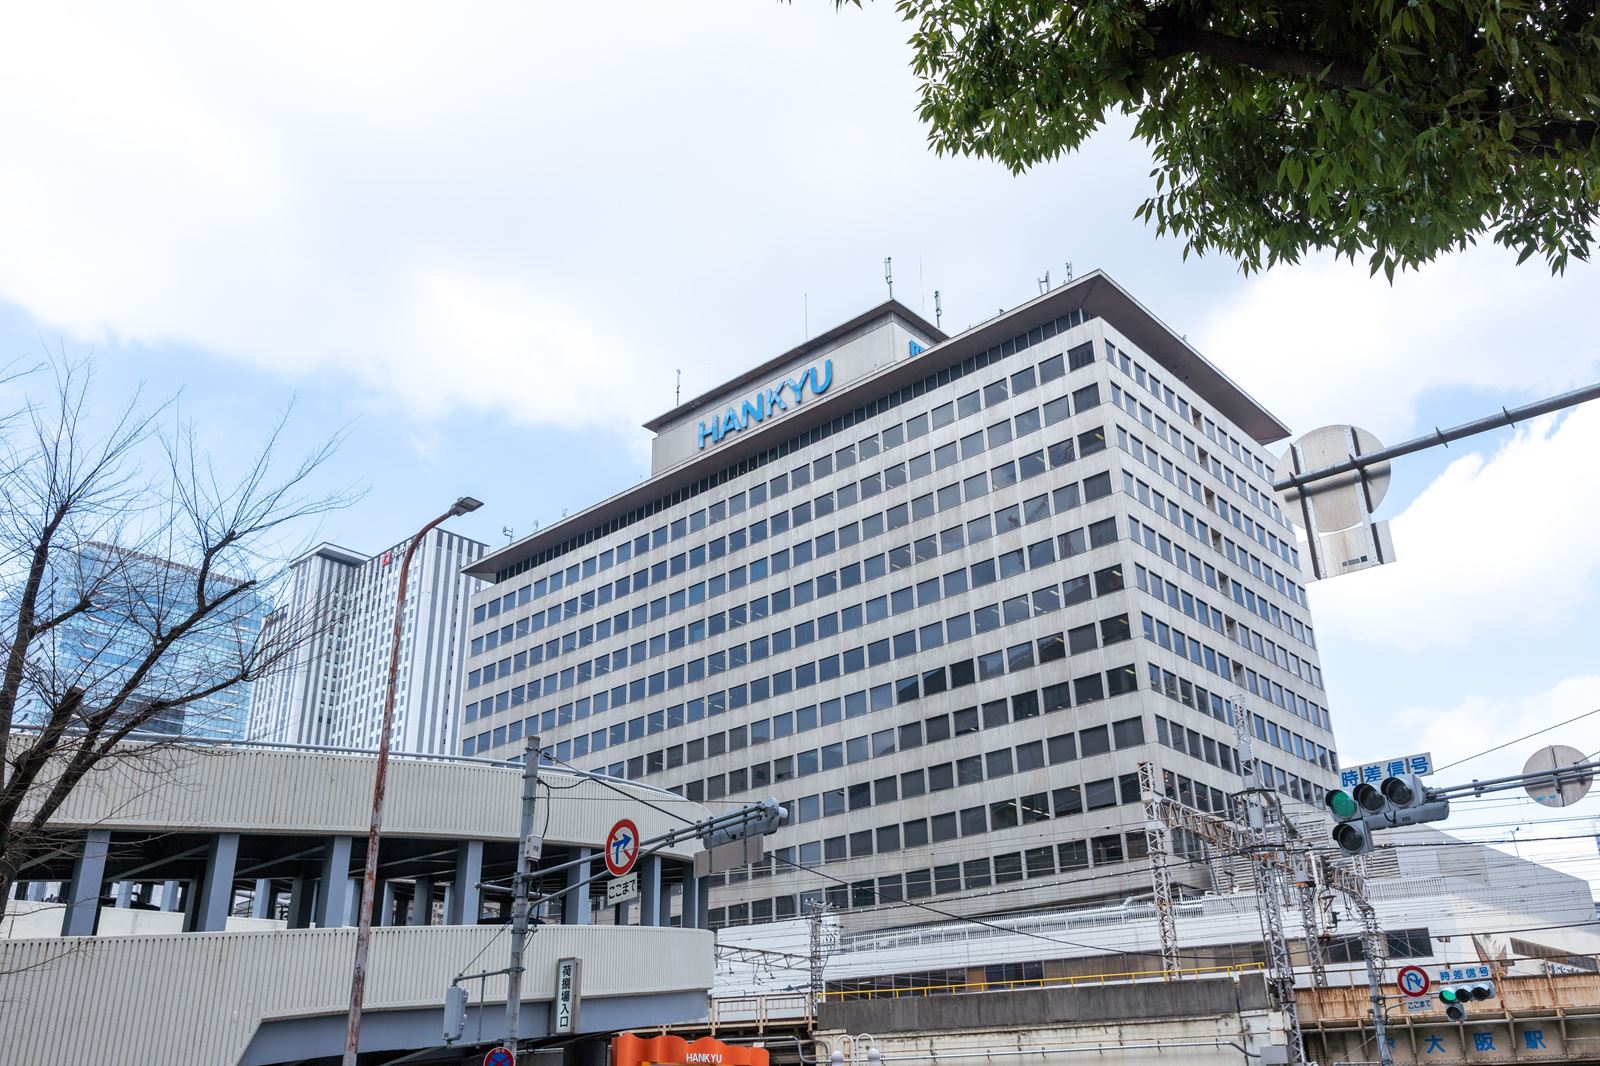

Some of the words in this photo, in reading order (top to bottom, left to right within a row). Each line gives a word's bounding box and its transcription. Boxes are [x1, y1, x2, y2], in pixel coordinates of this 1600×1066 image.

[698, 358, 832, 450] HANKYU
[1341, 756, 1429, 788] 時差信号
[608, 879, 636, 899] ここまで
[1440, 966, 1489, 981] 時差信号
[560, 965, 572, 1028] 荷捌場入口
[1407, 999, 1432, 1010] ここまで
[1424, 1030, 1547, 1054] 大阪駅
[686, 1052, 723, 1064] HANKYU
